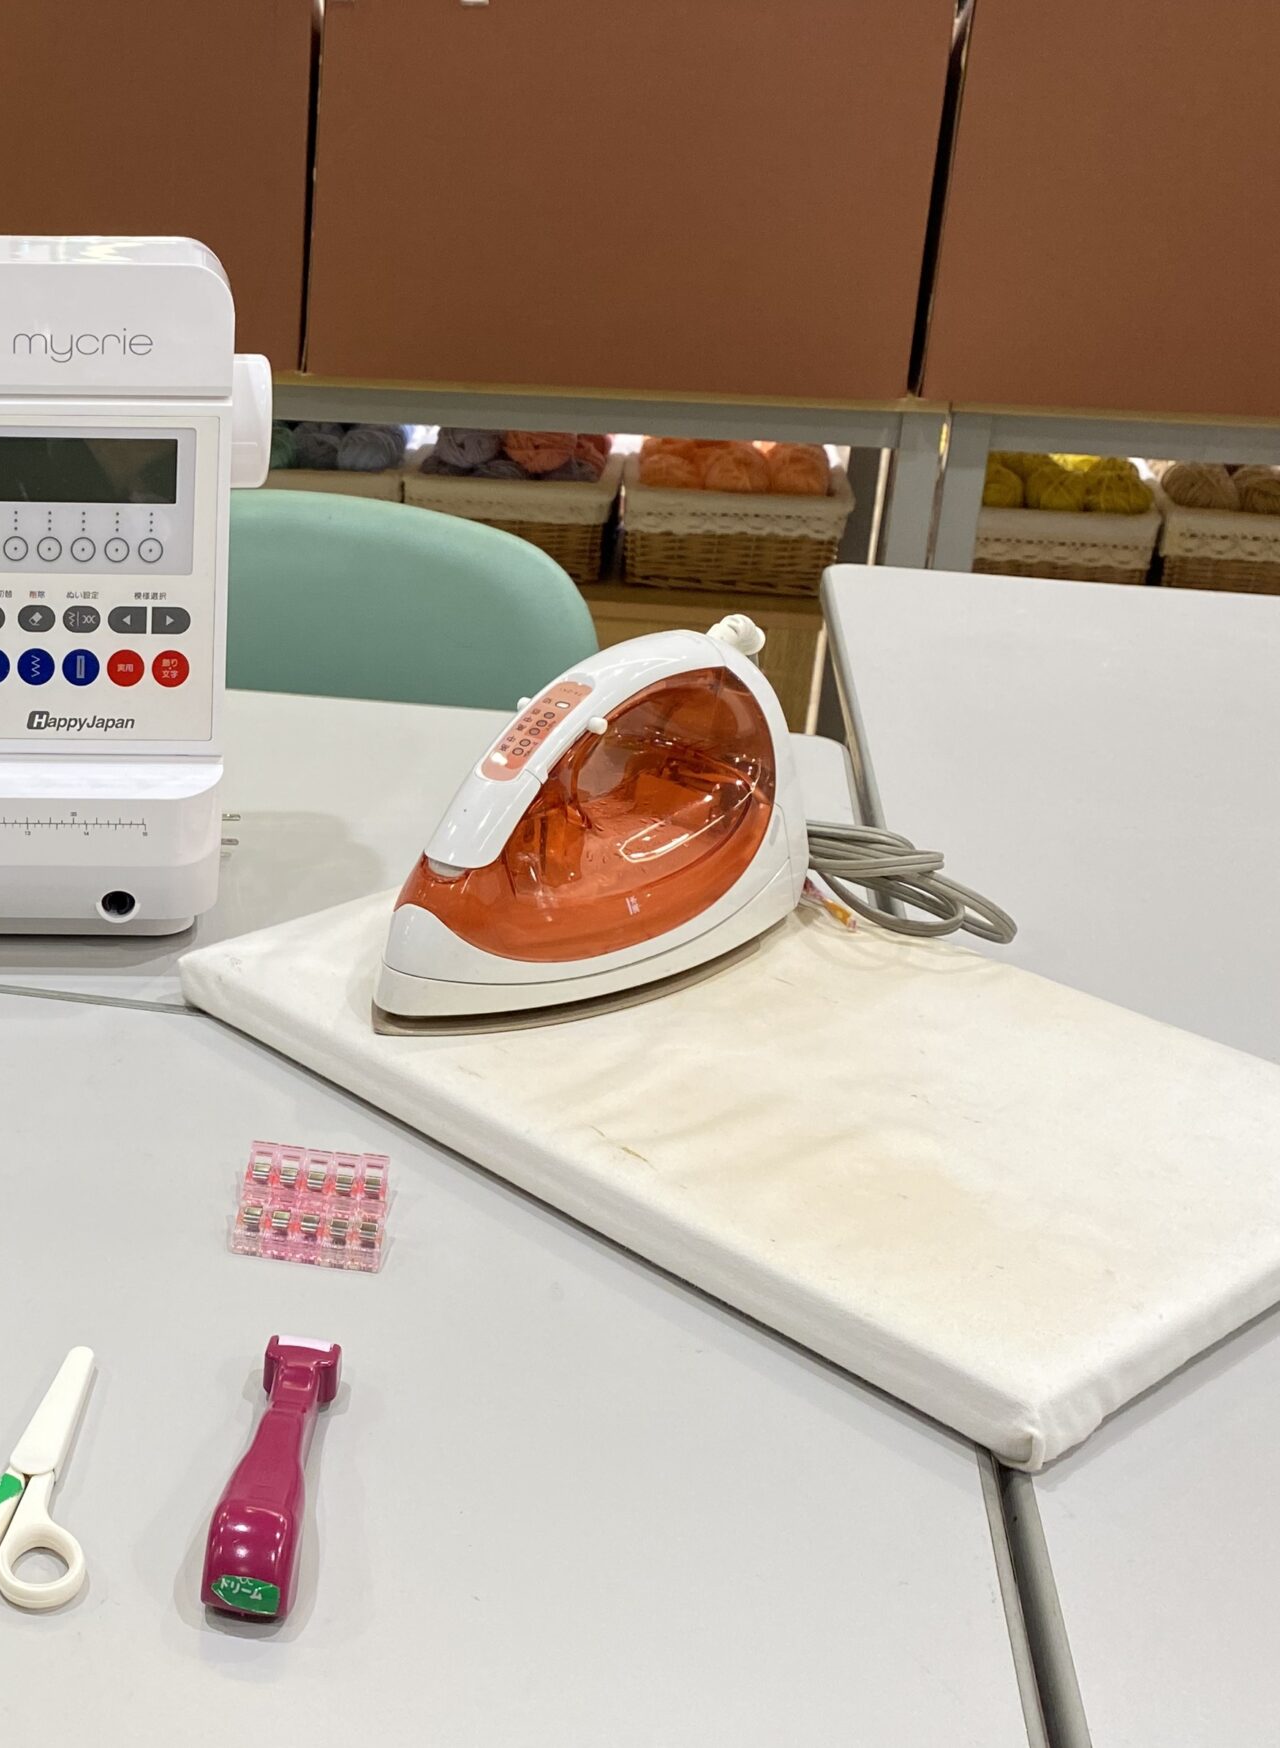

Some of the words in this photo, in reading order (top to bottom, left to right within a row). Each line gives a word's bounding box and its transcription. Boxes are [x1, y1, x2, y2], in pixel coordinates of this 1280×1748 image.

[12, 327, 154, 364] mycrie
[28, 590, 46, 600] 削除
[66, 590, 100, 600] ぬい設定
[133, 591, 168, 601] 模様選択
[116, 663, 135, 673] 実用
[26, 710, 136, 732] HappyJapan
[220, 1577, 263, 1601] ドリーム
